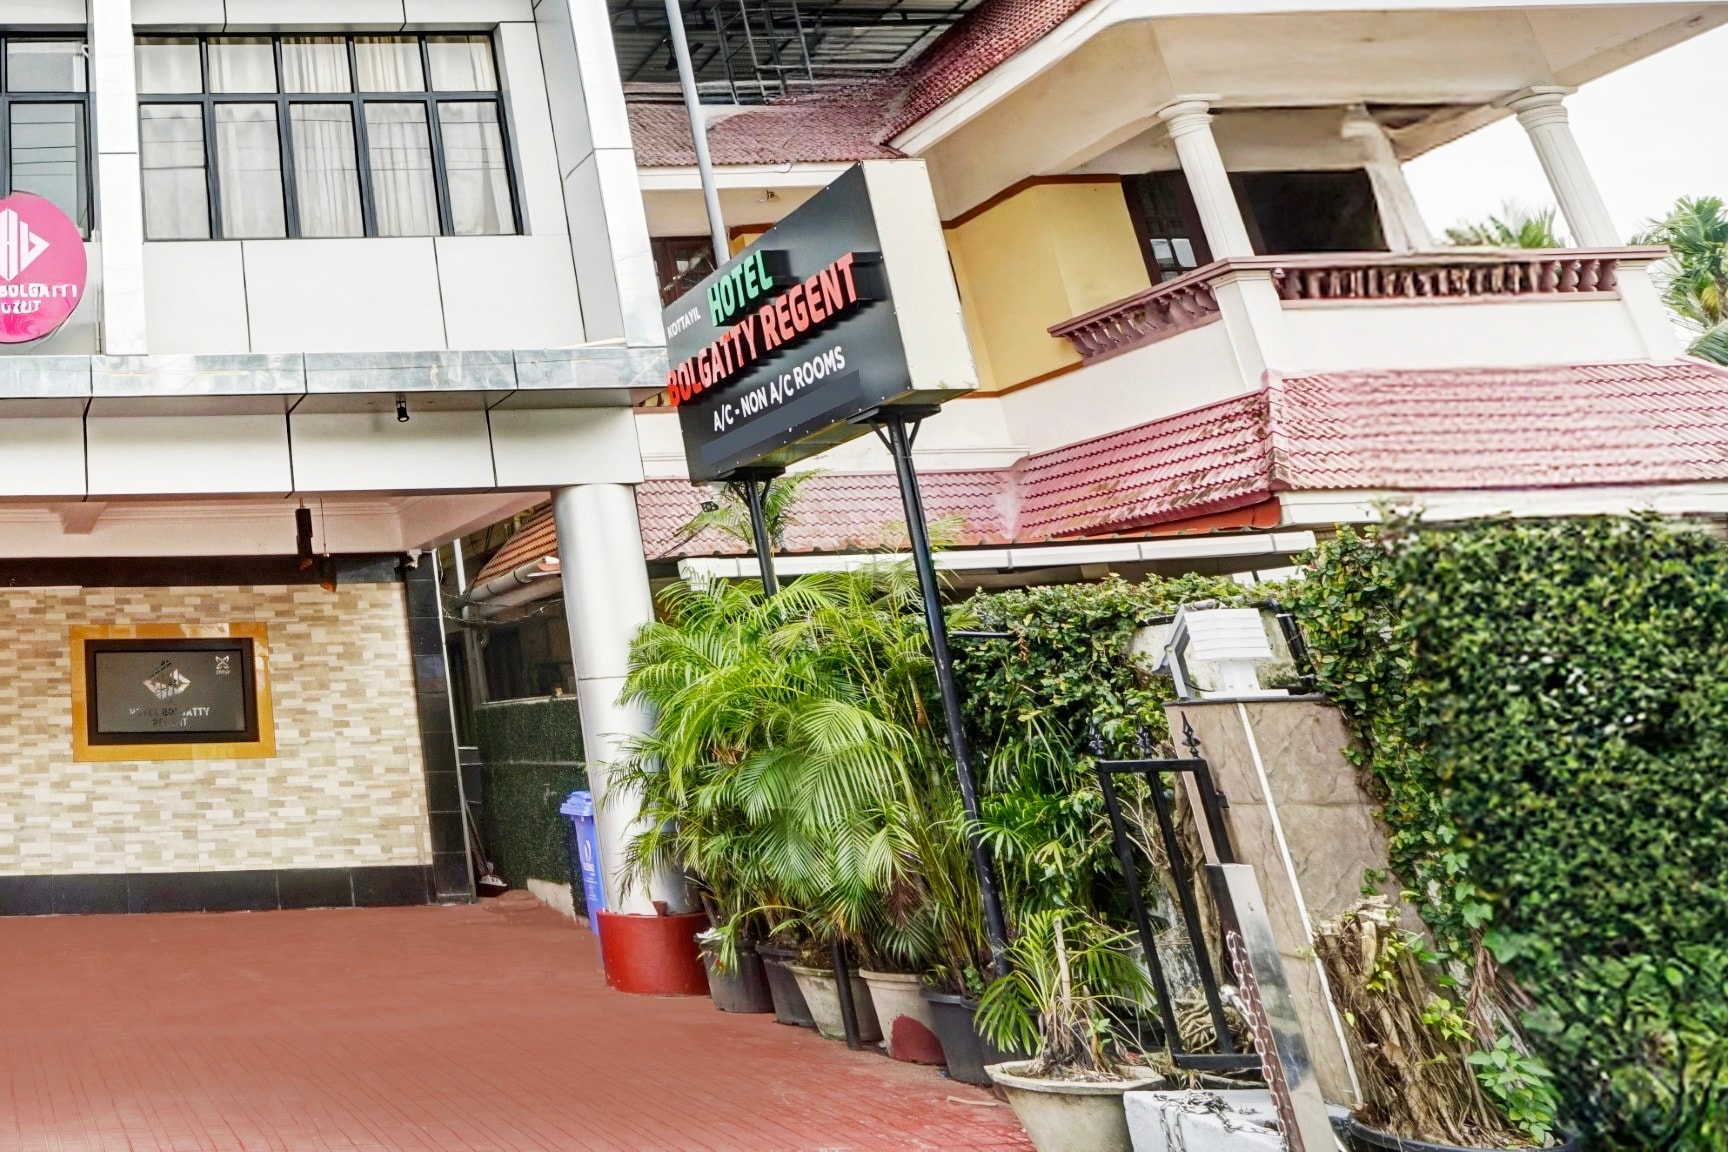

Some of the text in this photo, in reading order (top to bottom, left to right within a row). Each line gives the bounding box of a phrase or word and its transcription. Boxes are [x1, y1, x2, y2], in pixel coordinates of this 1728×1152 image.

[665, 252, 858, 408] BOLGATTY REGENT
[666, 249, 773, 339] KOTTAYIL HOTEL
[713, 404, 734, 432] A/C
[740, 386, 768, 418] NON
[770, 374, 794, 405] A/C
[792, 345, 846, 390] ROOMS
